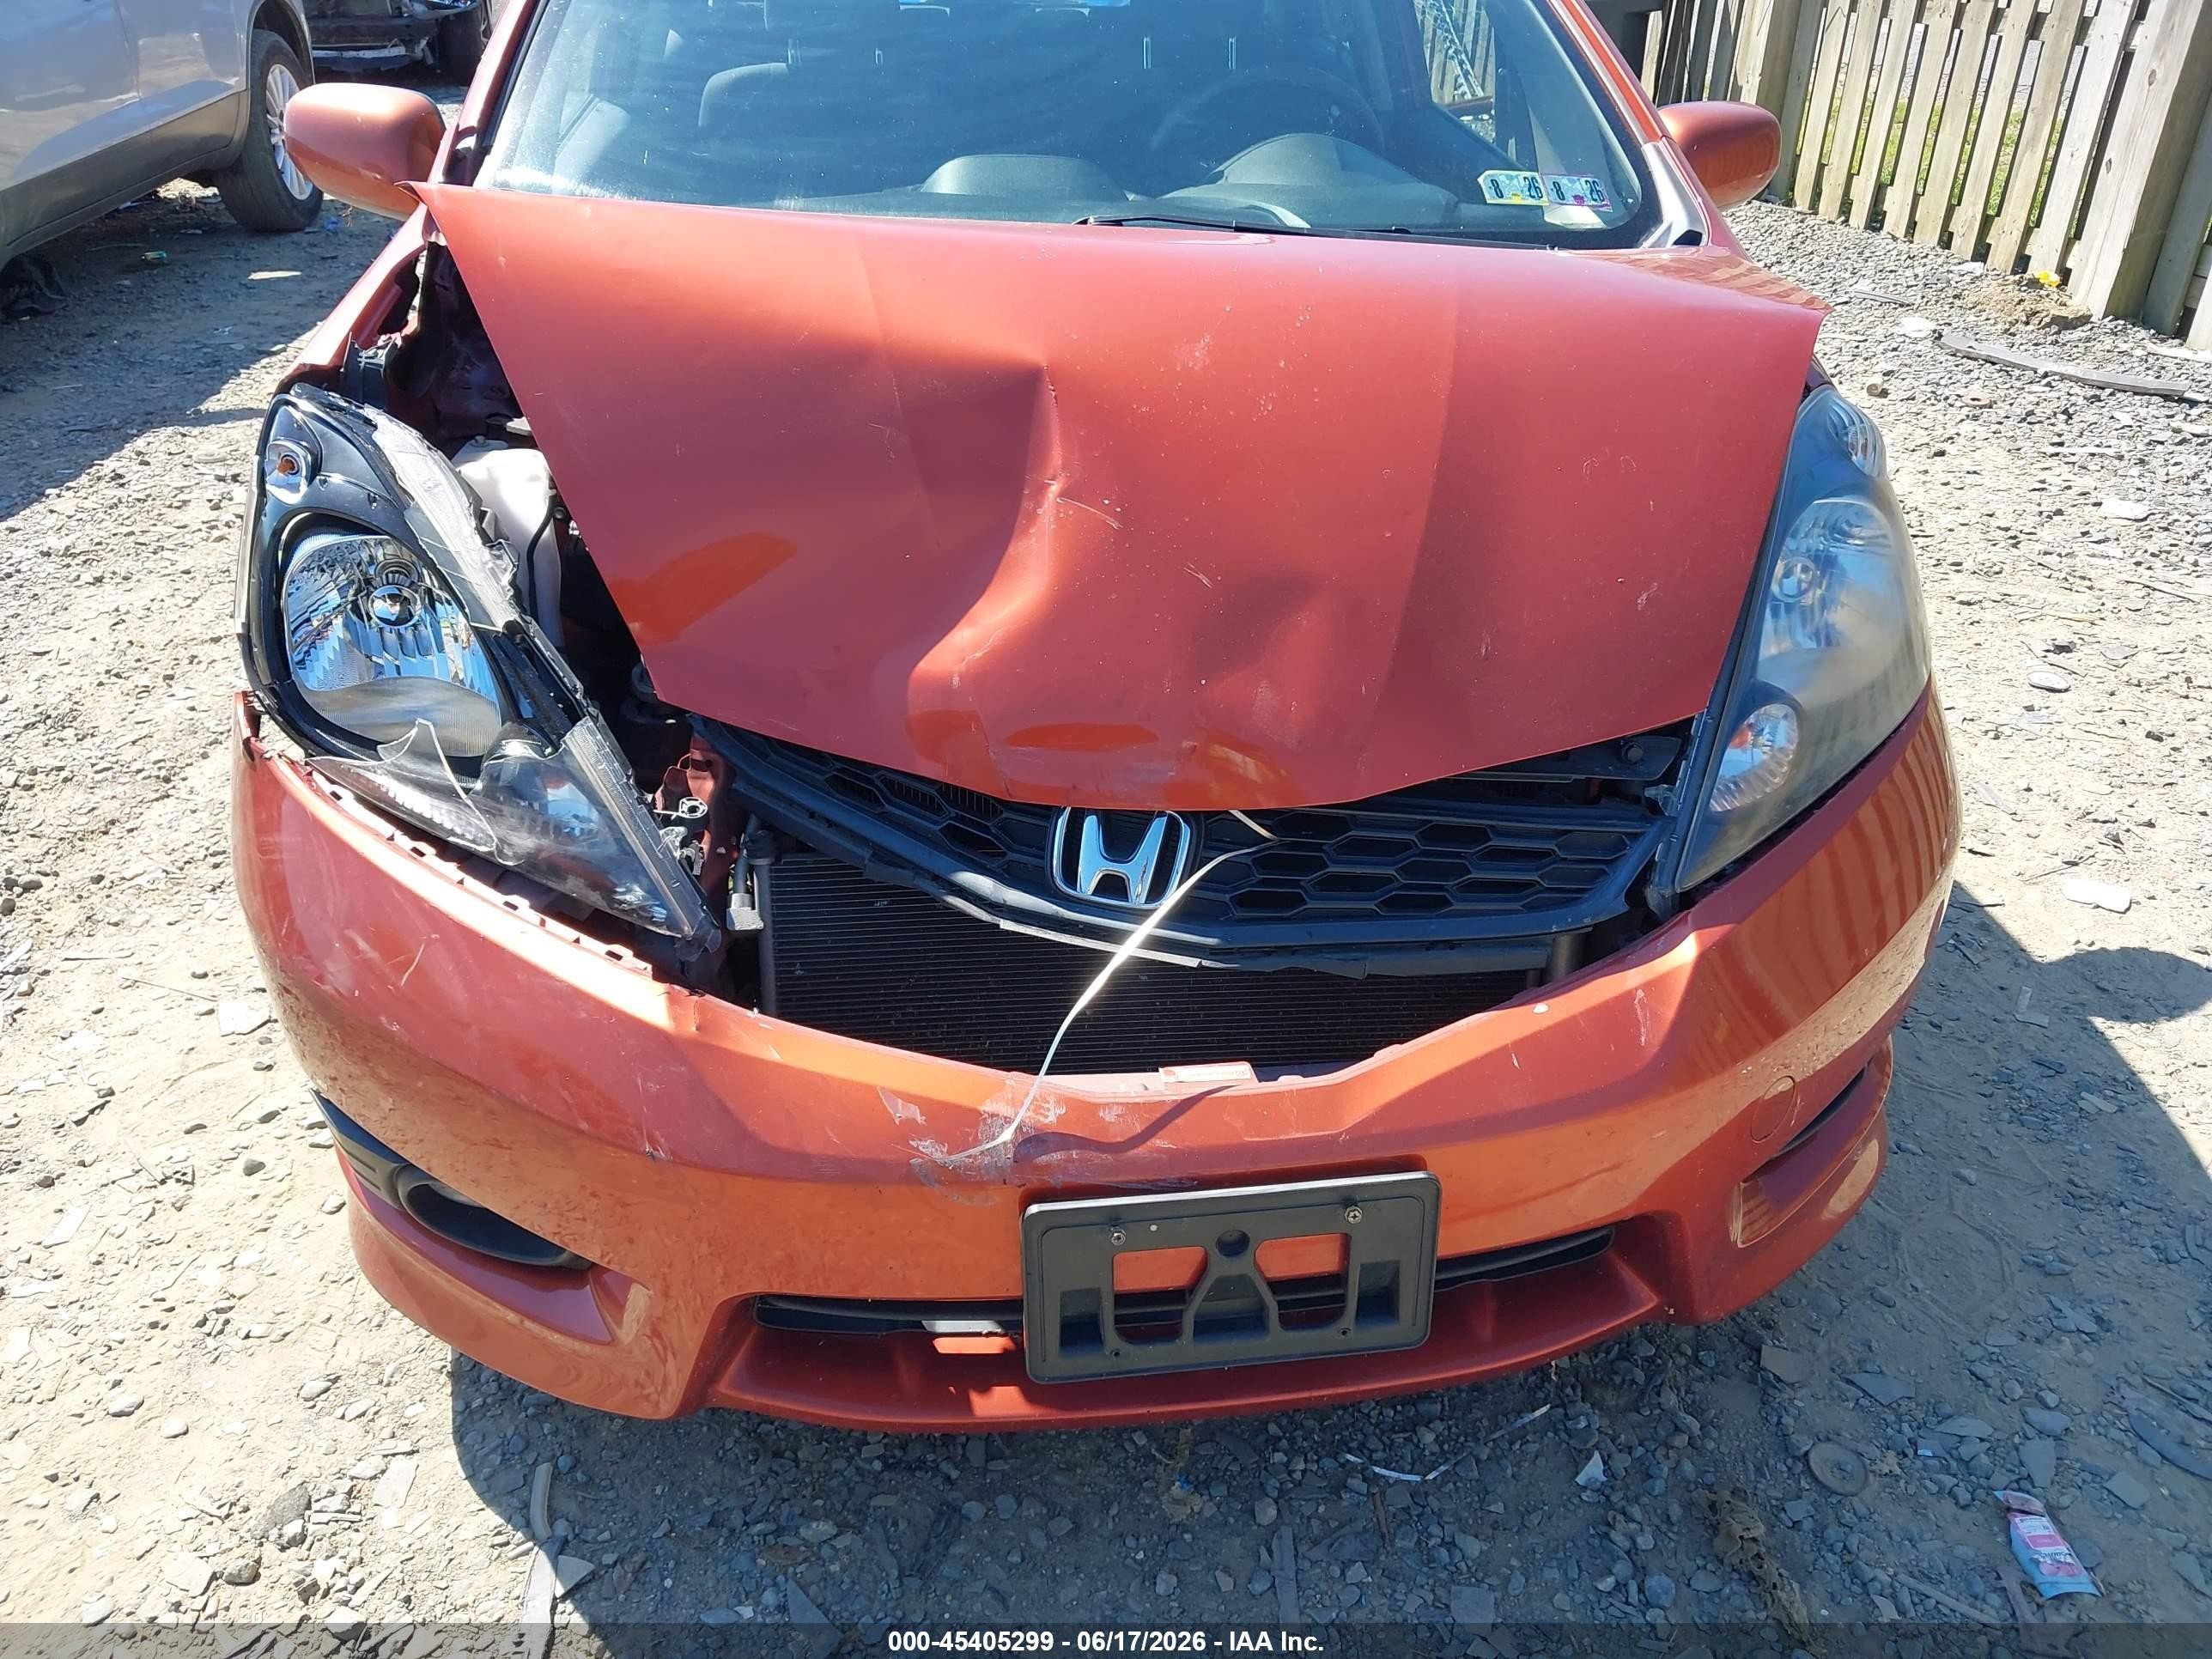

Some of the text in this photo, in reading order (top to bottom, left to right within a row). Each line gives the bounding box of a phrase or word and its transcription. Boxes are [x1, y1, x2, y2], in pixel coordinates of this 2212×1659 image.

[1490, 176, 1543, 199] 8 26
[1553, 179, 1605, 202] 8 26
